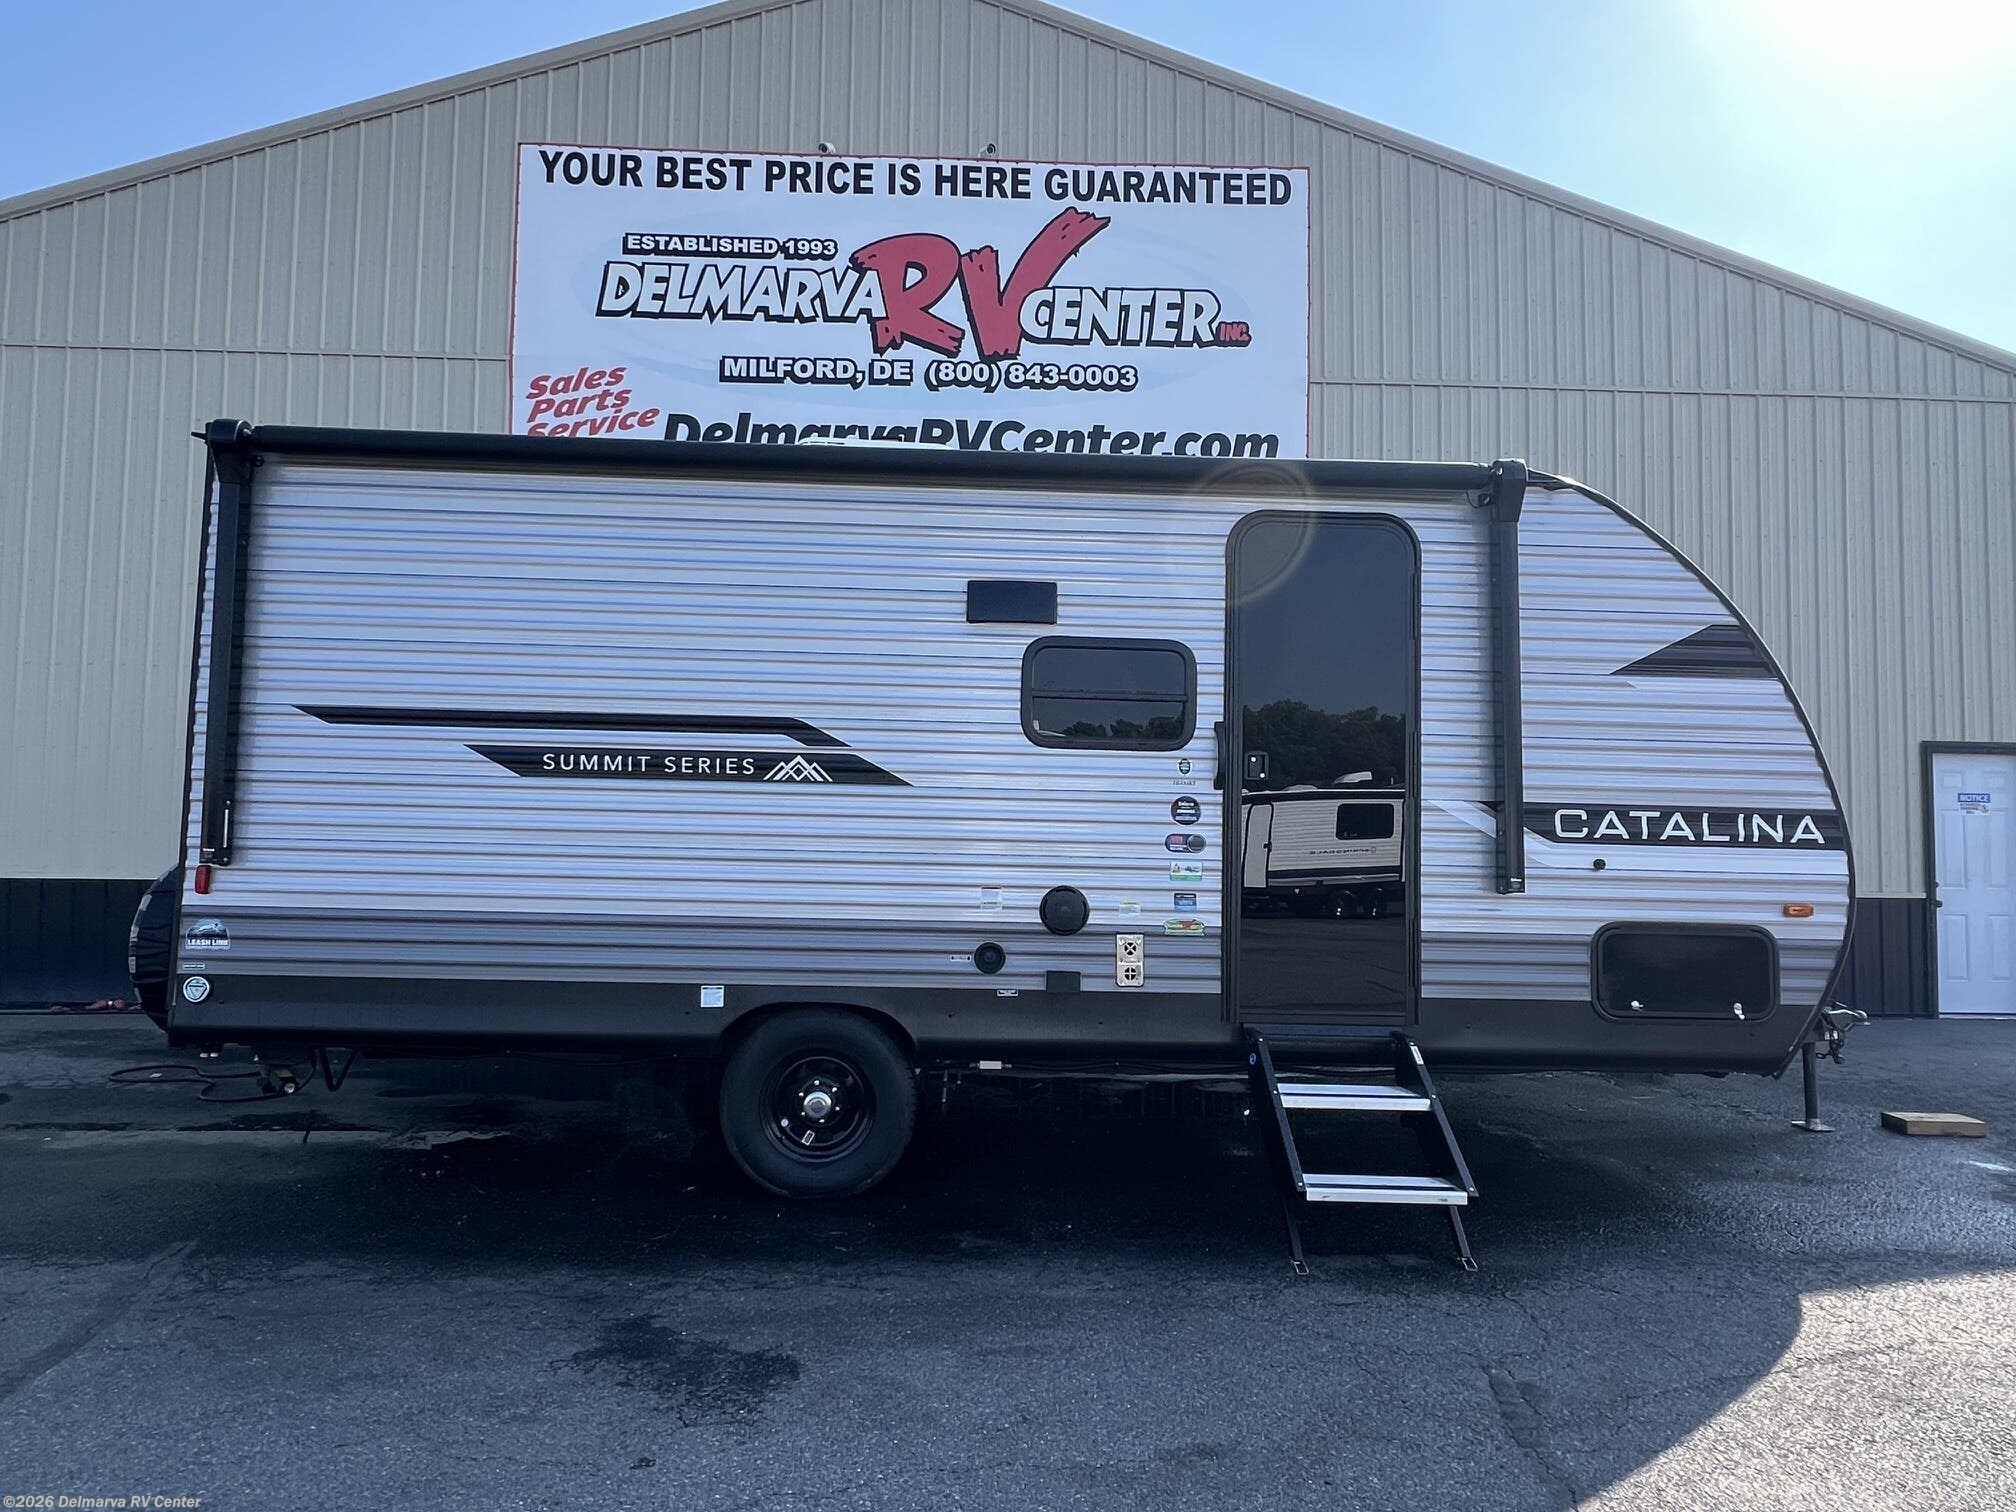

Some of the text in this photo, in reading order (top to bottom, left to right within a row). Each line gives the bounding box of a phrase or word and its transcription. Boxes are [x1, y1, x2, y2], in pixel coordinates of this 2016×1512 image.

[538, 150, 1292, 205] YOUR BEST PRICE IS HERE GUARANTEED
[625, 234, 837, 257] ESTABLISHED 1993
[597, 261, 888, 323] DELMARVA
[850, 206, 1111, 360] RV
[1019, 286, 1221, 348] CENTER
[525, 366, 627, 400] Sales
[722, 357, 1138, 391] MILFORD, DE (800) 843-0003
[526, 387, 632, 423] Parts
[663, 412, 1280, 458] DelmarvaRVCentercom
[542, 753, 755, 775] SUMMIT SERIES
[1960, 794, 1989, 802] NOTICE
[1553, 808, 1826, 844] CATALINA
